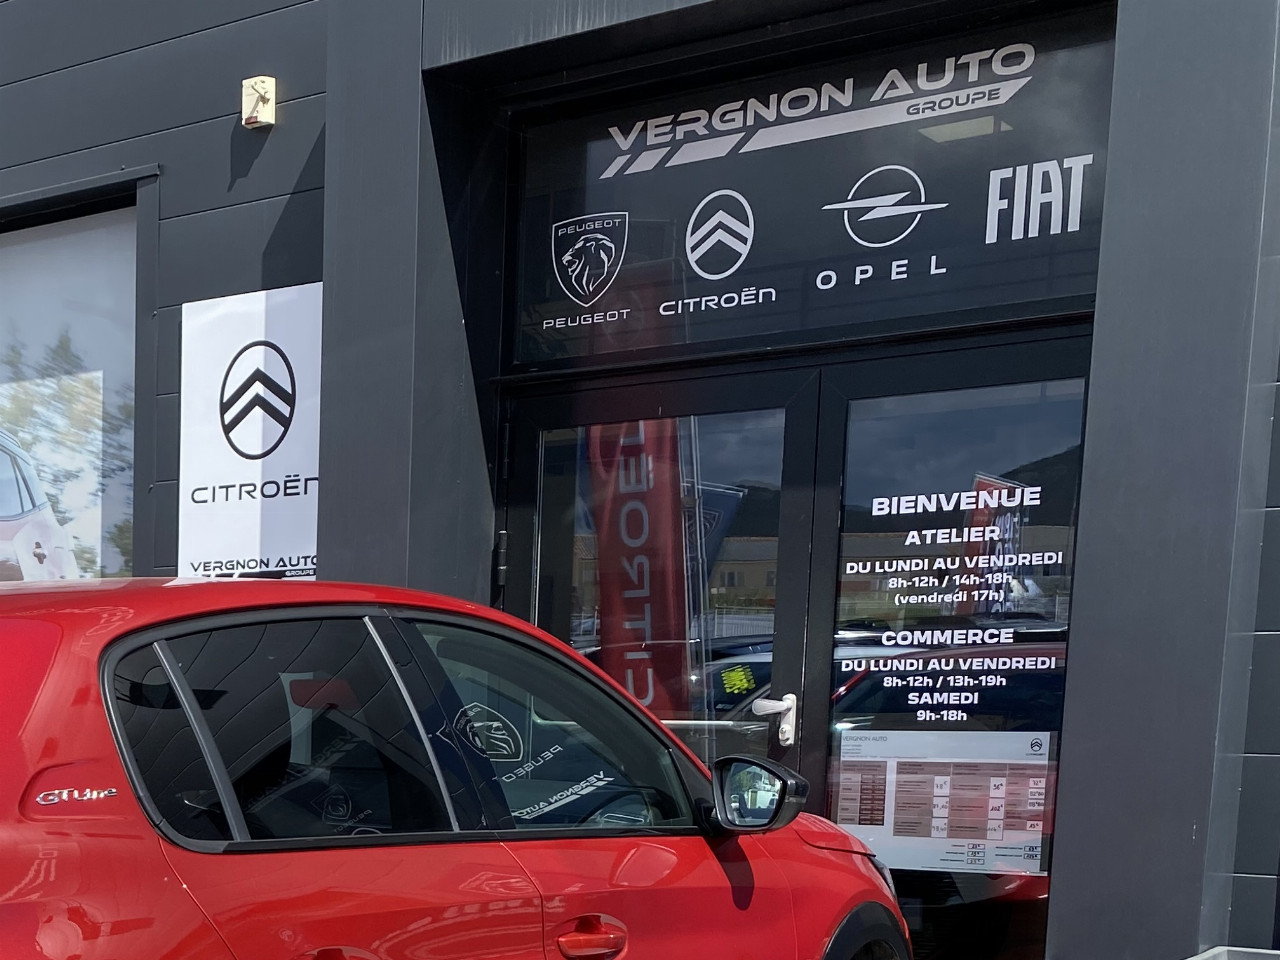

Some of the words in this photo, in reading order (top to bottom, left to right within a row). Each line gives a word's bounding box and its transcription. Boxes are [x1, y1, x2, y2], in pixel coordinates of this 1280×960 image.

[608, 77, 854, 151] VERGNON
[871, 43, 1036, 100] AUTO
[906, 87, 1000, 116] GROUPE
[986, 154, 1094, 244] FIAT
[558, 217, 622, 237] PEUGEOT
[815, 254, 946, 291] OPEL
[542, 307, 631, 329] PEUGEOT
[871, 486, 1041, 516] BIENVENUE
[904, 526, 1000, 546] ATELIER
[190, 558, 269, 573] VERGNON
[846, 561, 871, 574] DU
[875, 558, 928, 573] LUNDI
[932, 556, 960, 571] AU
[964, 551, 1063, 568] VENDREDI
[888, 574, 938, 588] 8h-12h
[952, 572, 1012, 587] 14h-18h
[894, 590, 967, 606] (vendredi
[971, 588, 1005, 604] 17h)
[881, 628, 1014, 646] COMMERCE
[841, 660, 865, 672] DU
[869, 659, 923, 672] LUNDI
[927, 658, 954, 671] AU
[959, 657, 1056, 671] VENDREDI
[883, 675, 932, 687] 8h-12h
[946, 675, 1006, 687] 13h-19h
[907, 692, 979, 705] SAMEDI
[917, 709, 967, 722] 9h-18h
